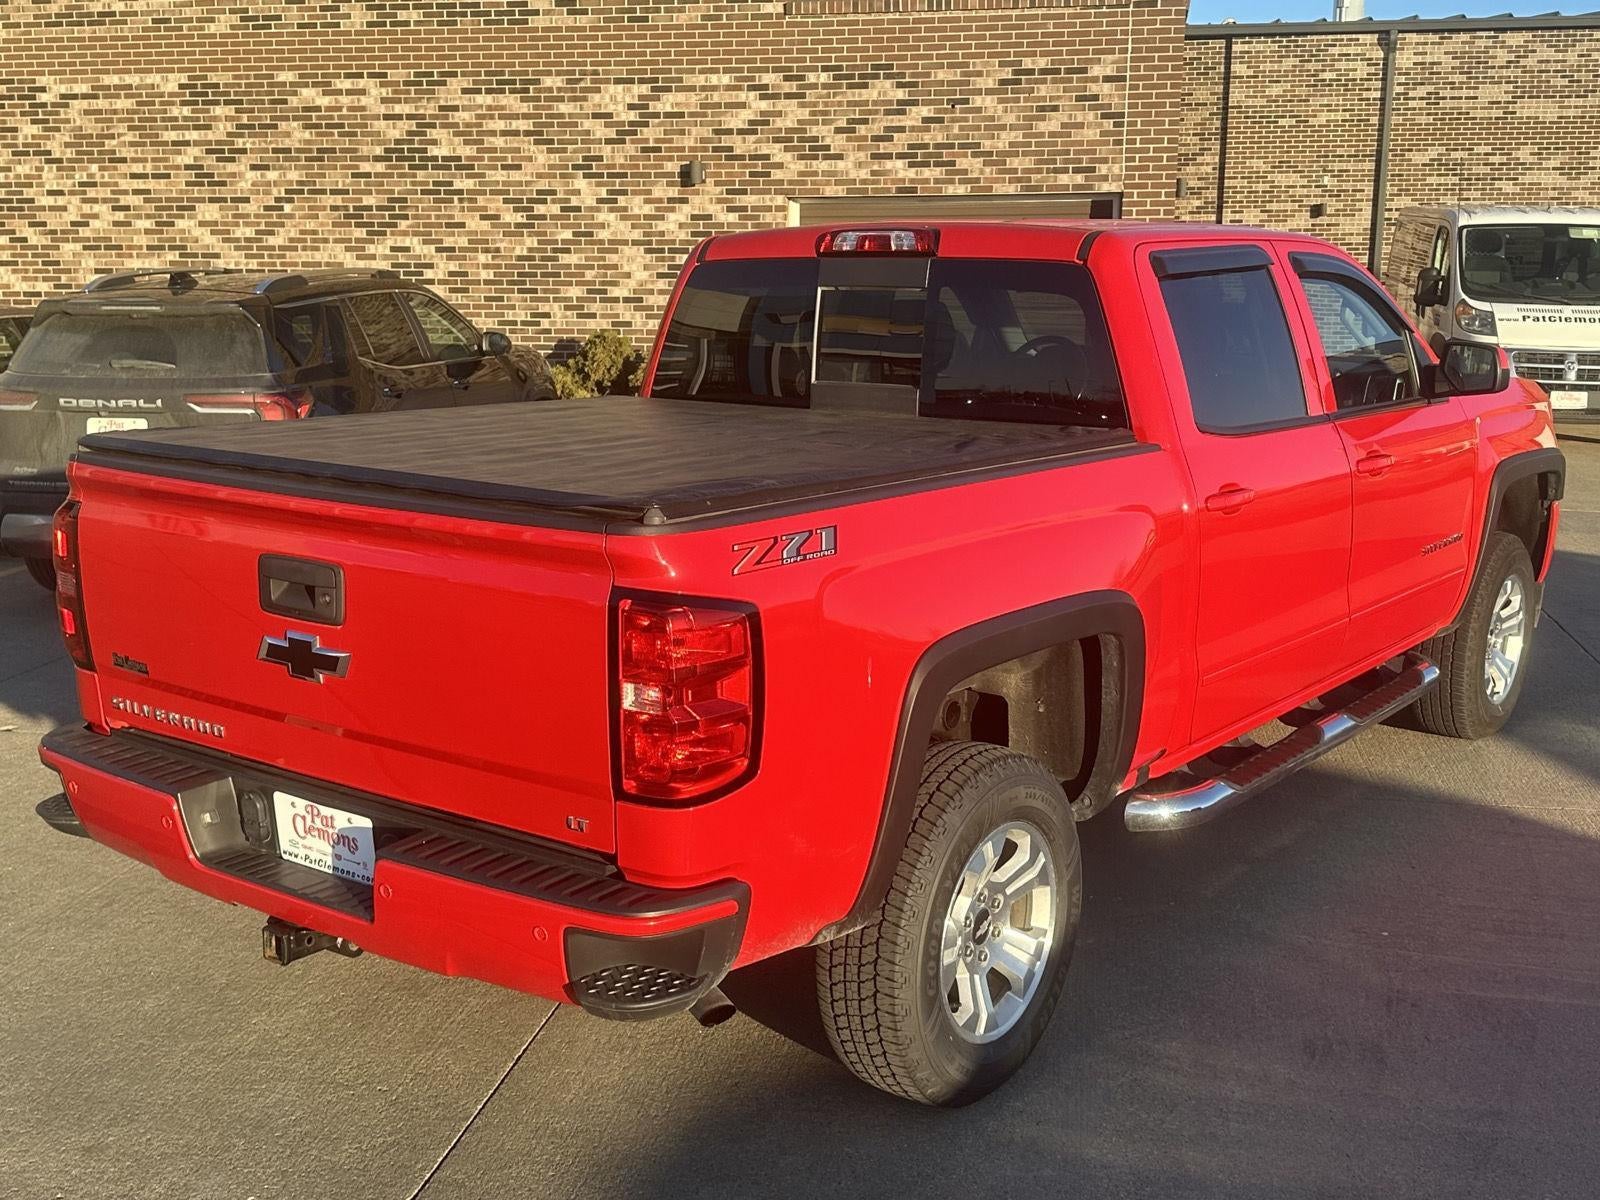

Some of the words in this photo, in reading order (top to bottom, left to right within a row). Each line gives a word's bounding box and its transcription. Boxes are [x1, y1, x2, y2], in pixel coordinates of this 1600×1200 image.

[1522, 315, 1600, 324] PatClemo
[59, 398, 162, 408] DENALI
[732, 525, 837, 576] Z71
[783, 555, 804, 565] OFF
[806, 548, 836, 560] ROAD
[112, 696, 225, 738] SILVERADO
[305, 803, 336, 830] Pat
[566, 815, 590, 833] LT
[292, 812, 359, 855] Clemons
